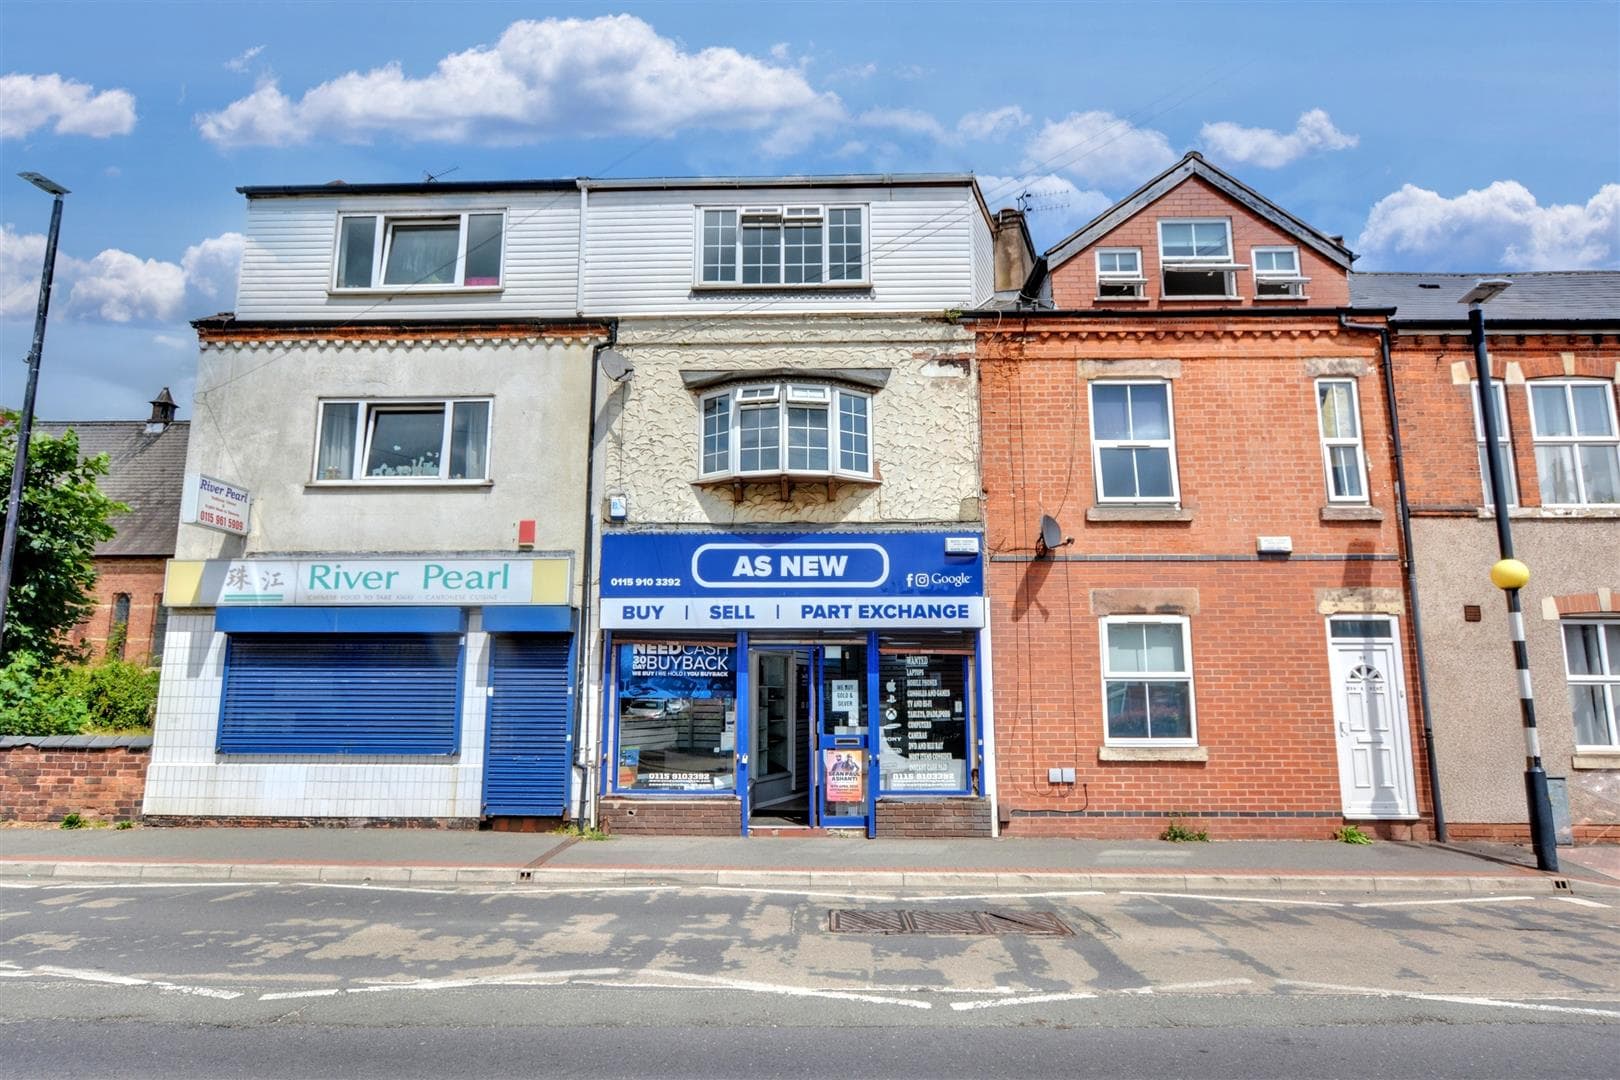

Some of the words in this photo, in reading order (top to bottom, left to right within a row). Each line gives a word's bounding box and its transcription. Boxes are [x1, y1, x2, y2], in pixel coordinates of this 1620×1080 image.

[200, 479, 224, 495] River
[225, 487, 248, 503] Pearl
[200, 511, 214, 523] 0115
[732, 555, 772, 577] AS
[780, 555, 848, 577] NEW
[226, 565, 284, 591] 珠江
[309, 564, 399, 590] River
[423, 563, 510, 590] Pearl
[610, 578, 633, 586] 0115
[635, 578, 654, 586] 910
[655, 578, 681, 586] 3392
[931, 573, 970, 587] Google
[622, 605, 664, 620] BUY
[709, 605, 755, 620] SELL
[801, 604, 852, 619] PART
[858, 604, 969, 619] EXCHANGE
[632, 656, 646, 664] 30
[647, 655, 728, 670] BUYBACK
[906, 656, 928, 664] WANTED
[906, 668, 924, 676] LAPTOPS
[908, 731, 927, 739] CAMERAS
[648, 772, 670, 780] 0115
